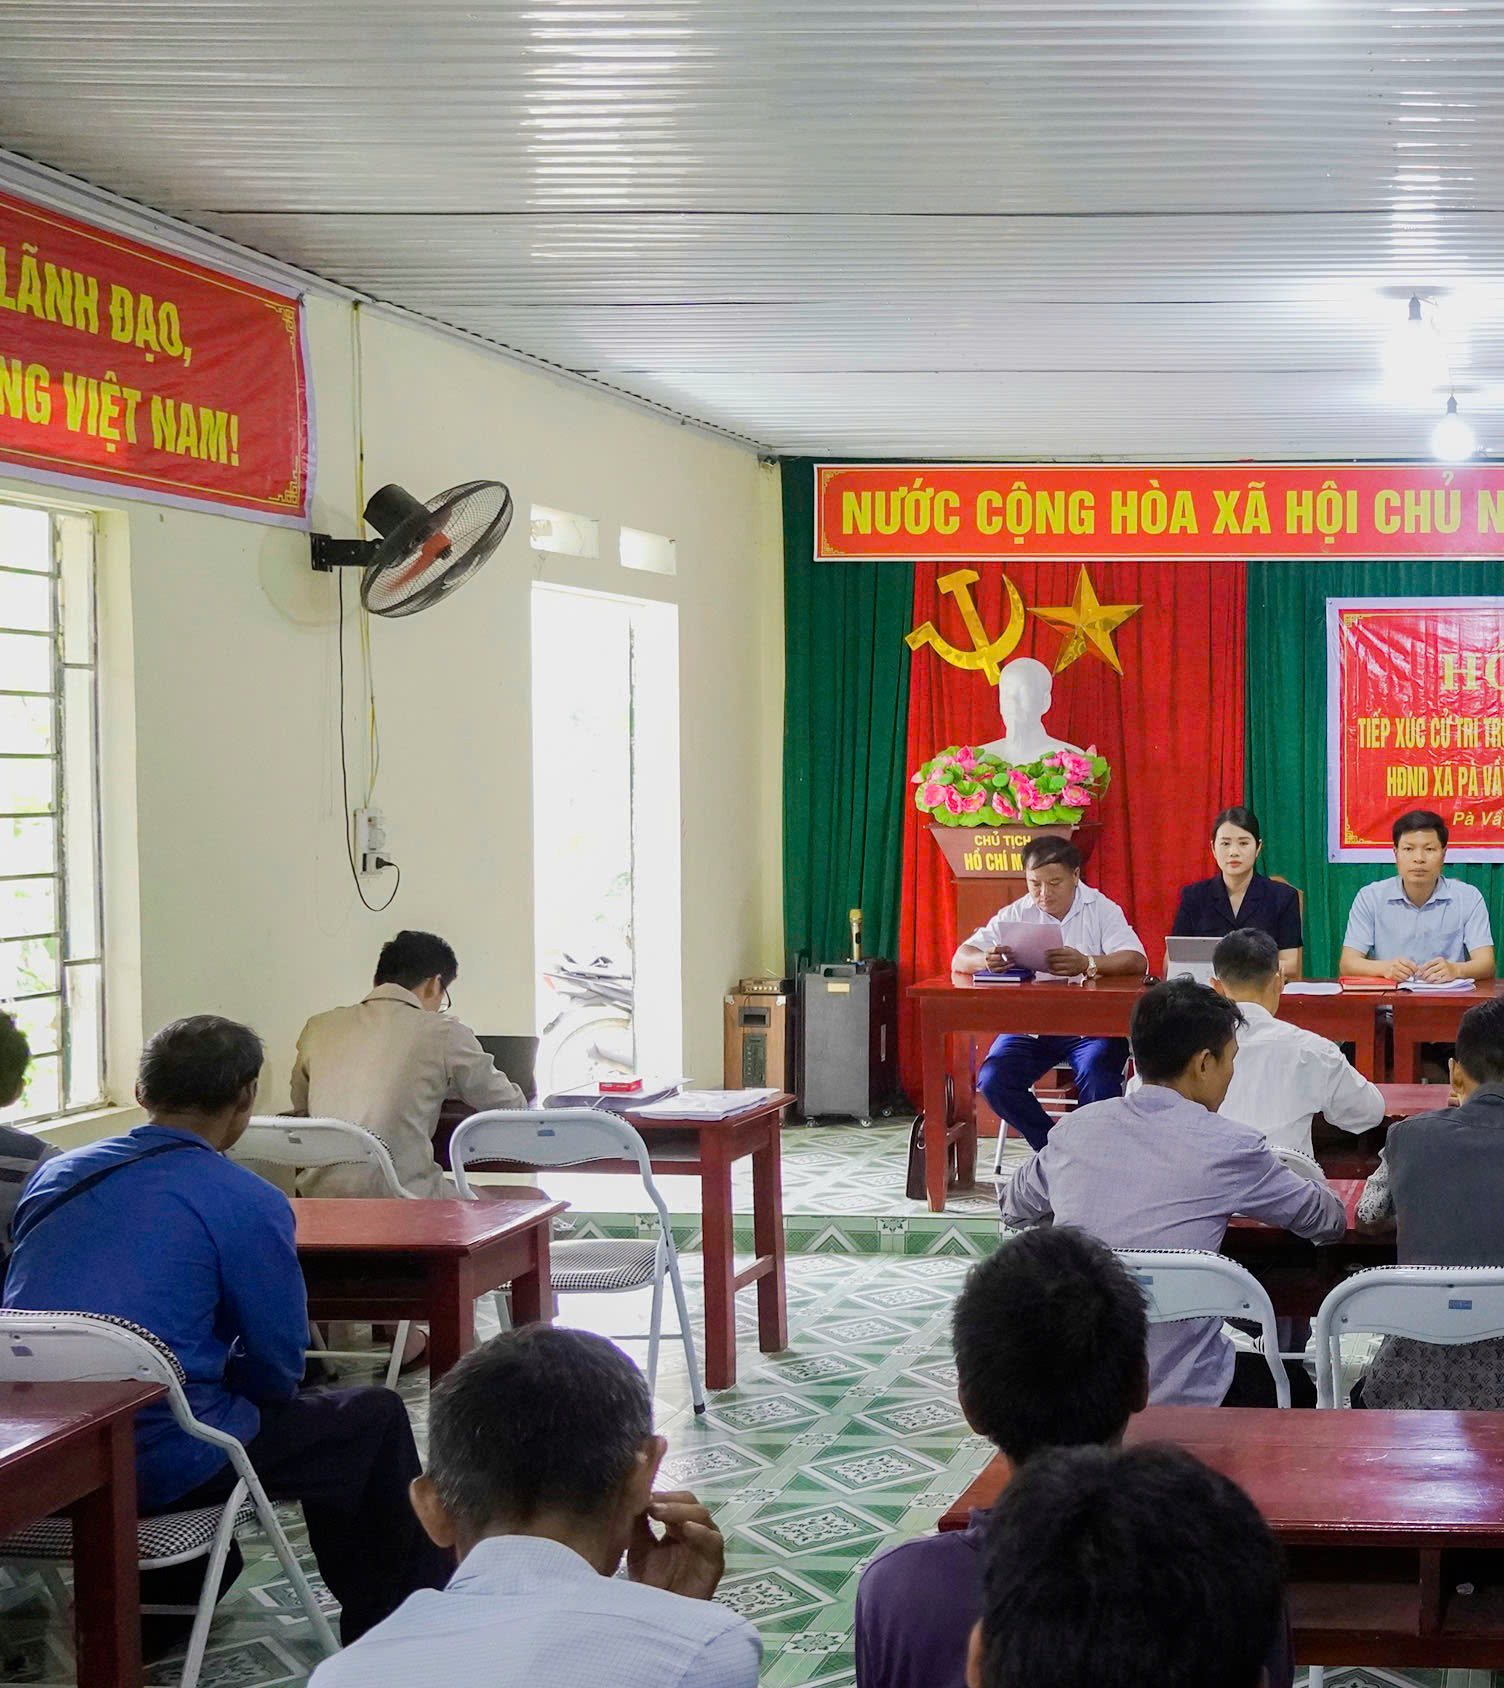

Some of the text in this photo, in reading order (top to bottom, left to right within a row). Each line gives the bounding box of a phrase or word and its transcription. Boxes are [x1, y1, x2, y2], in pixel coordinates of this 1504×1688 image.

[0, 241, 193, 368] LÃNH ĐẠO,
[62, 370, 142, 454] VIỆT
[150, 394, 240, 467] NAM!
[842, 478, 961, 535] NƯỚC
[975, 481, 1095, 544] CỘNG
[1111, 480, 1198, 534] HÒA
[1212, 481, 1272, 534] XÃ
[1286, 480, 1358, 544] HỘI
[1373, 471, 1461, 534] CHỦ
[1357, 708, 1390, 749] TIẾP
[1395, 710, 1426, 749] XÚC
[1430, 708, 1451, 748] CỬ
[1456, 717, 1479, 748] TRI
[1386, 766, 1428, 797] HĐND
[1432, 761, 1453, 797] XÃ
[1457, 761, 1478, 797] PÀ
[1453, 812, 1475, 826] Pà
[974, 830, 1032, 849] CHỦ TỊCH
[964, 847, 1024, 871] HỒ CHÍ M
